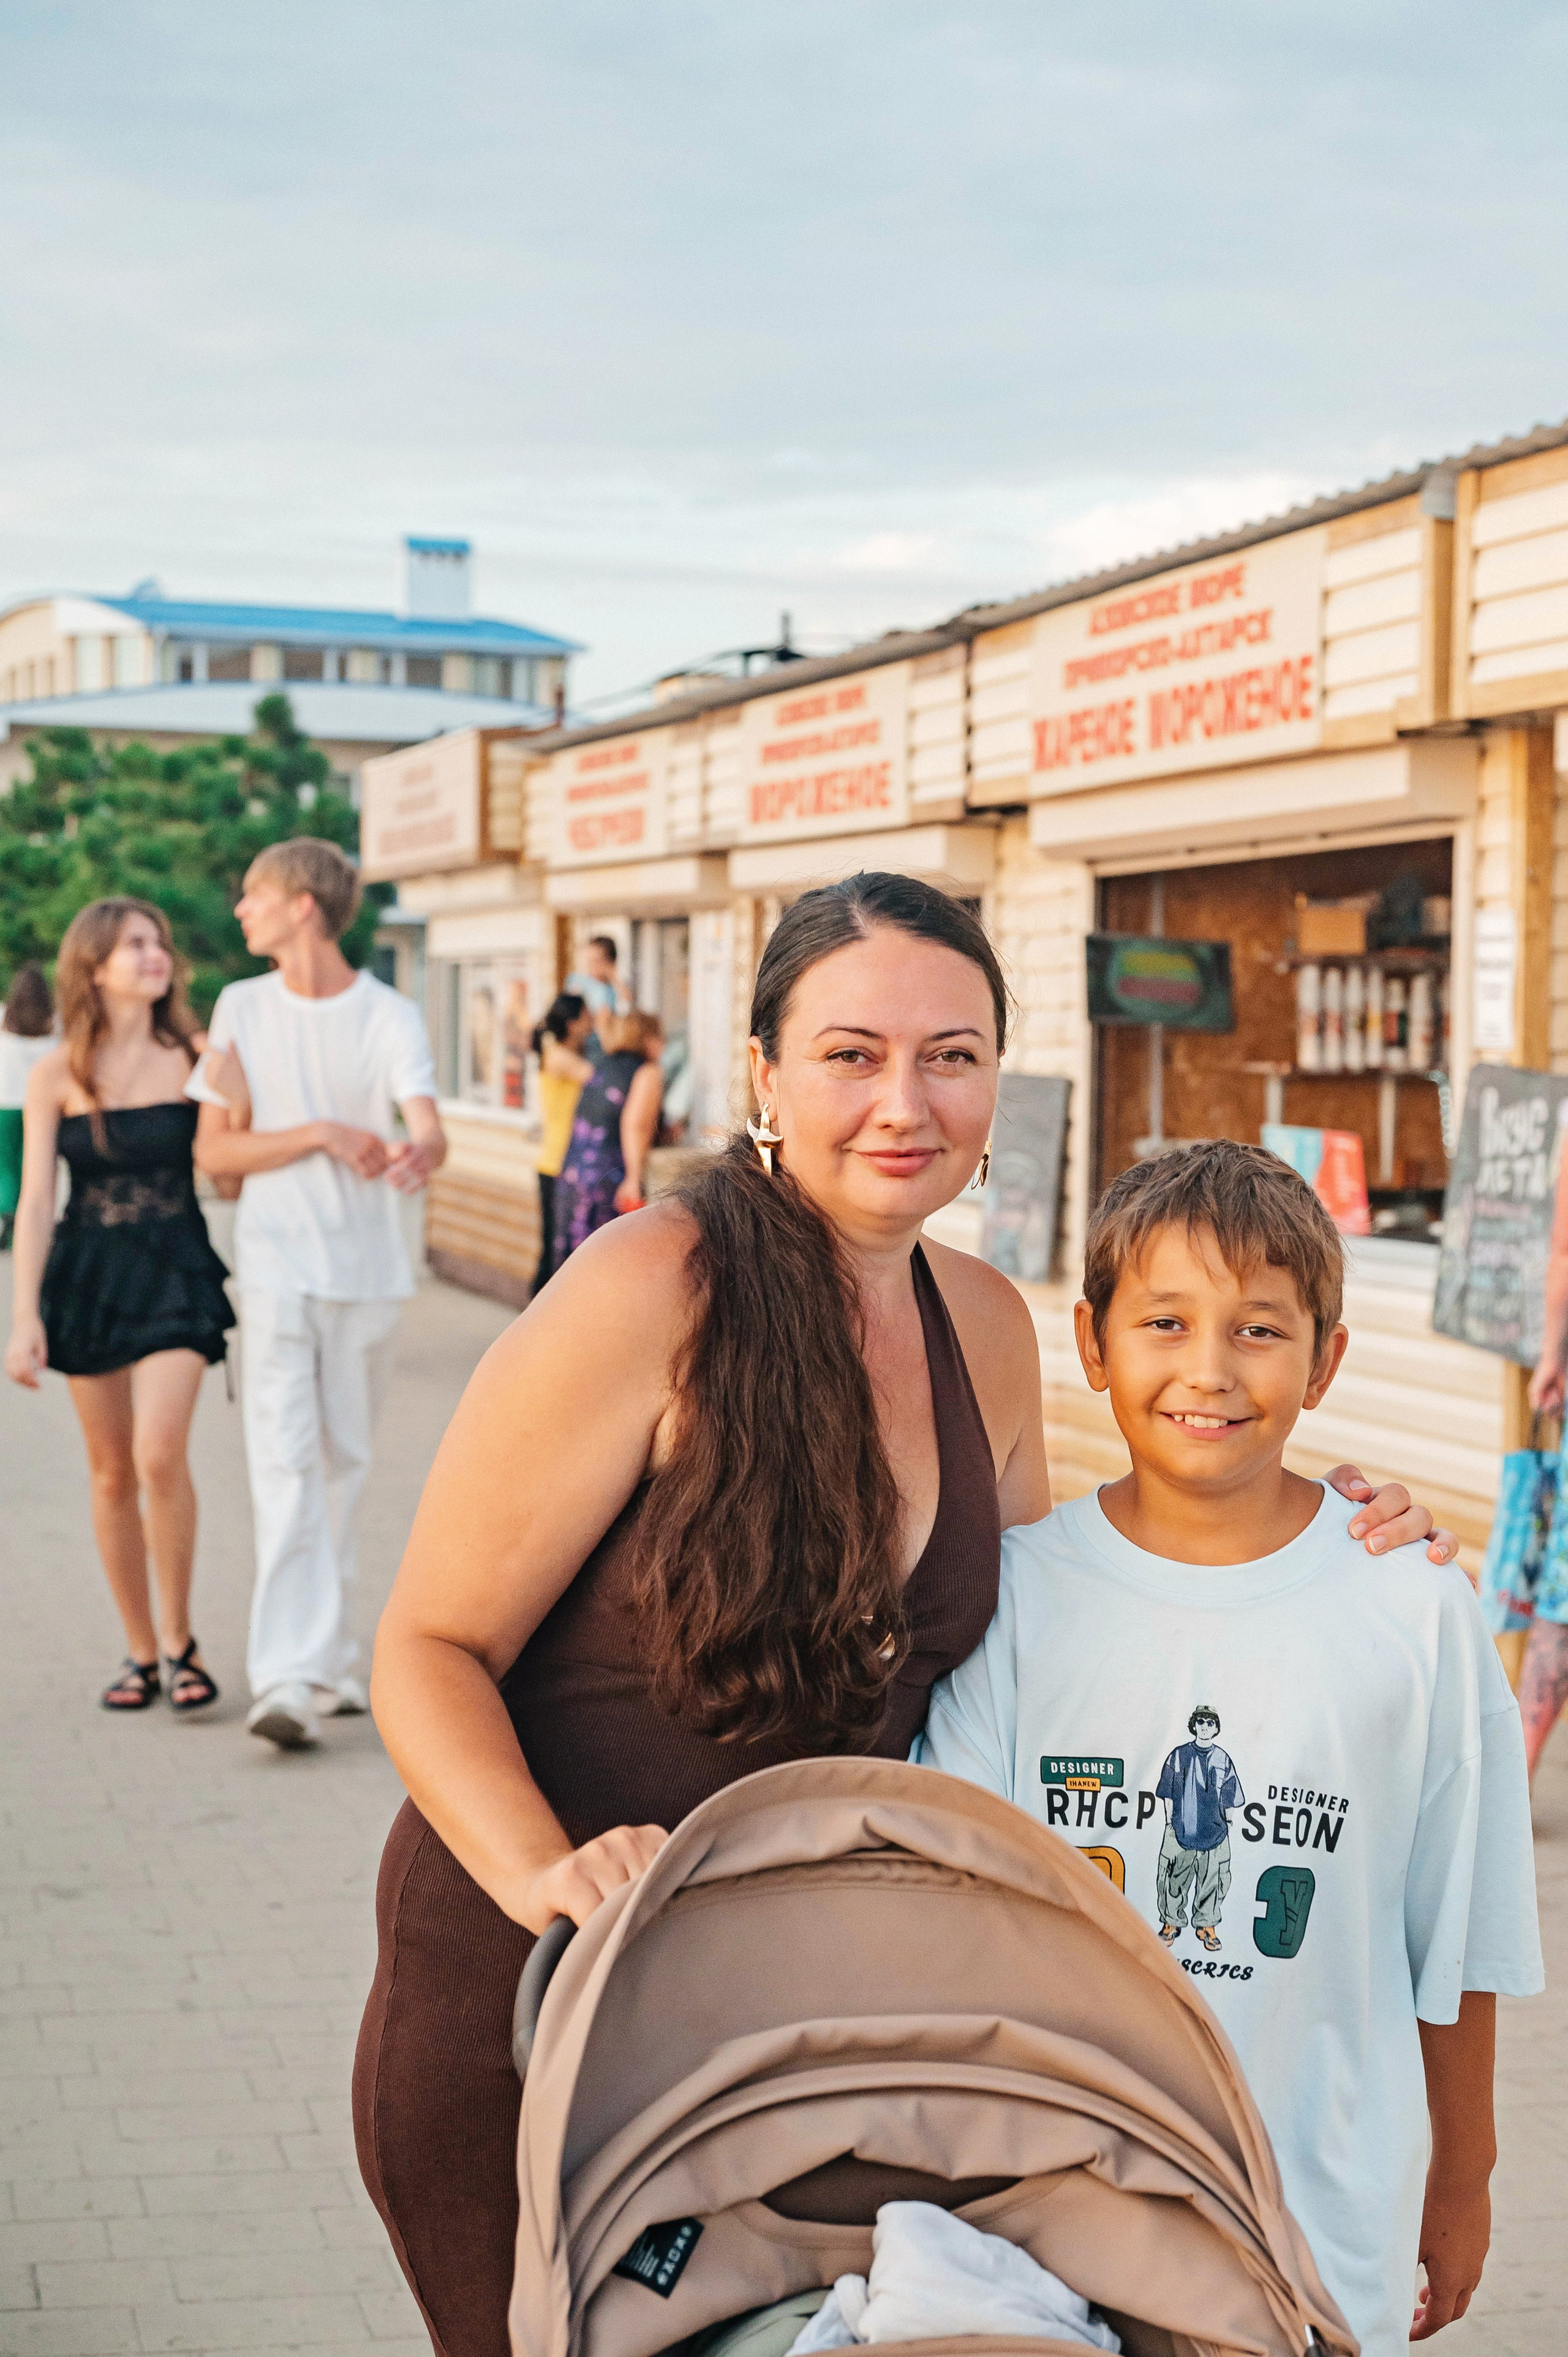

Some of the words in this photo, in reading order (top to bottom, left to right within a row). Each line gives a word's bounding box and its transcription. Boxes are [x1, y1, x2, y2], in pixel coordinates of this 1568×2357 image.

[1148, 655, 1314, 750] МОРОЖЕНОЕ
[1050, 1762, 1114, 1776] DESIGNER
[1046, 1788, 1156, 1830] RHCP
[1268, 1785, 1349, 1814] DESIGNER
[1242, 1802, 1344, 1854] SEON
